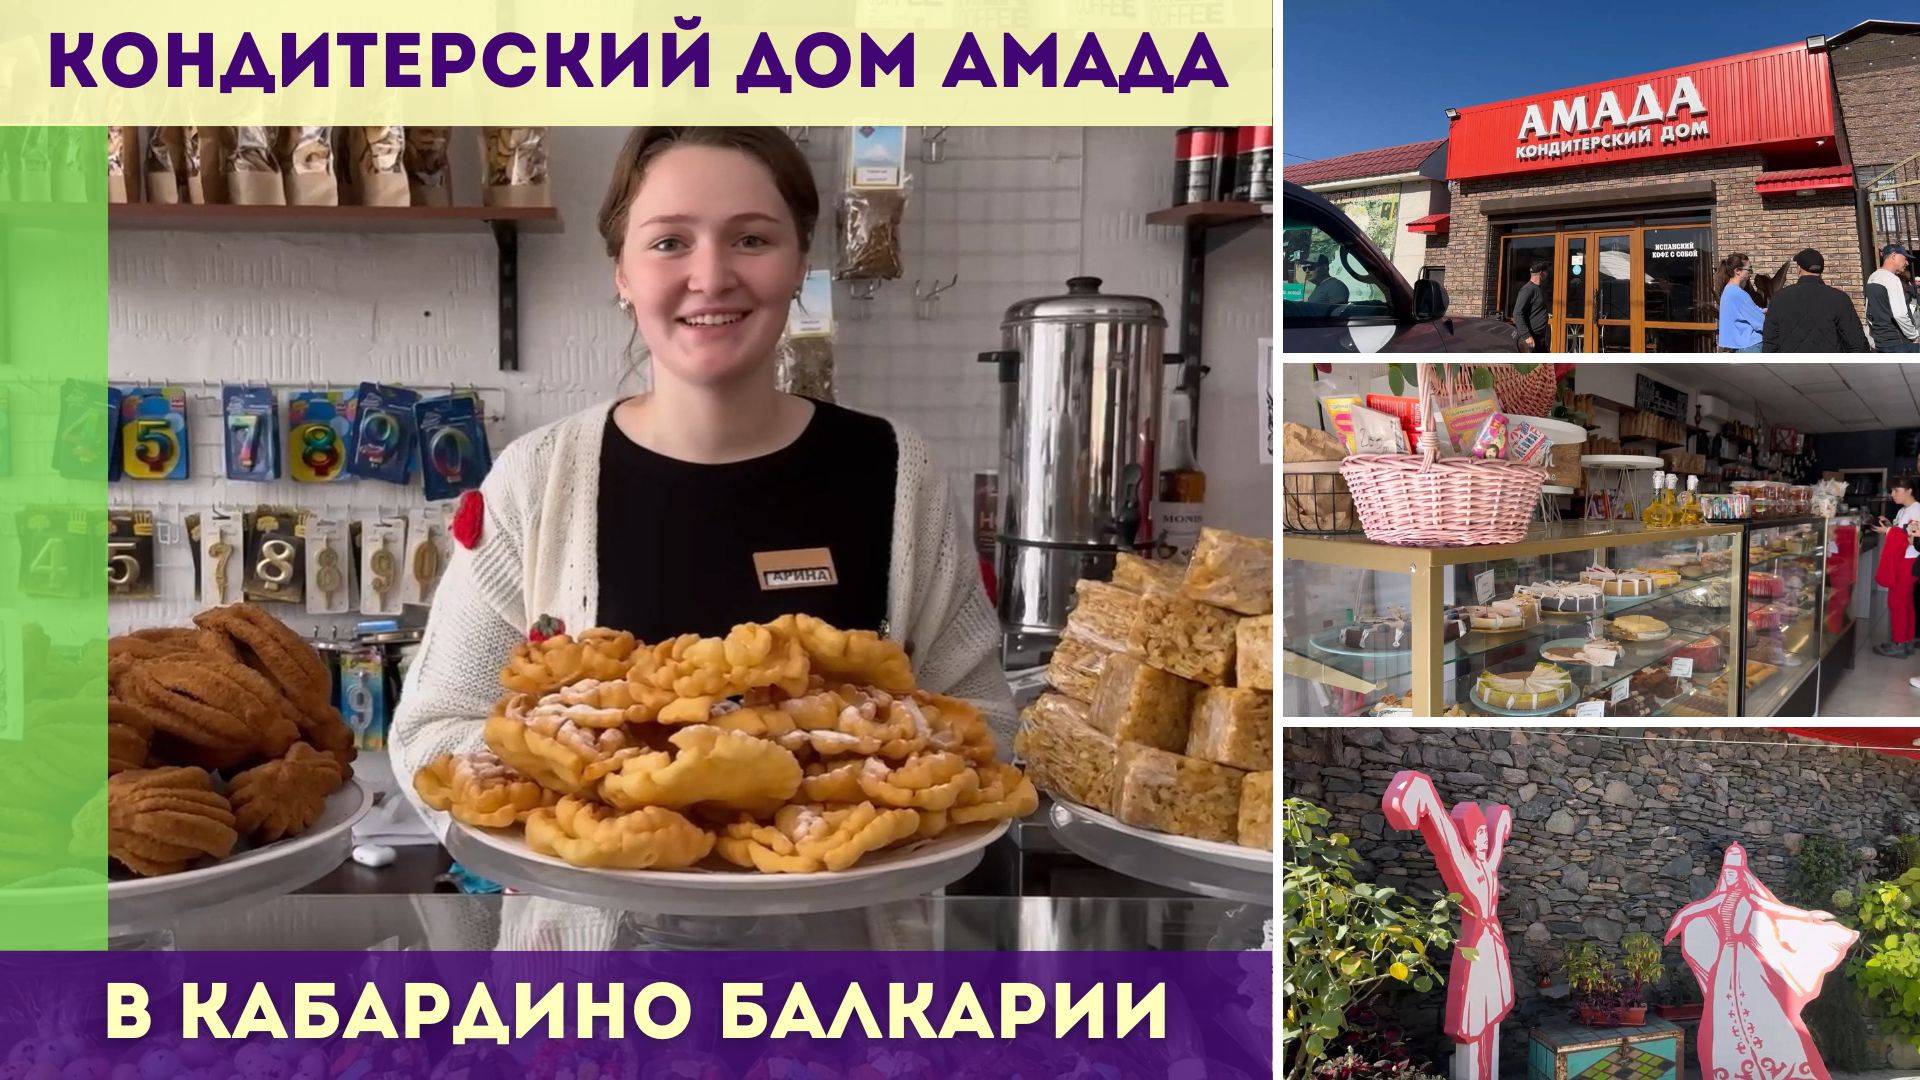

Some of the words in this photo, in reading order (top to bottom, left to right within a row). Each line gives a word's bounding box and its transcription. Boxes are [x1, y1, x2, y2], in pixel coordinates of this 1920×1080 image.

[1517, 76, 1709, 142] АМАДА
[1516, 126, 1652, 160] КОНДИТЕРСКИЙ
[1660, 120, 1710, 146] ДОМ
[1652, 251, 1669, 259] КОФЕ
[1676, 250, 1699, 258] СОБОЙ
[1654, 241, 1695, 251] ИСПАНСКИЙ
[134, 418, 179, 466] 5
[228, 414, 261, 466] 7
[302, 423, 339, 469] 8
[256, 540, 296, 583] 8
[370, 549, 396, 593] 9
[348, 686, 374, 732] 9
